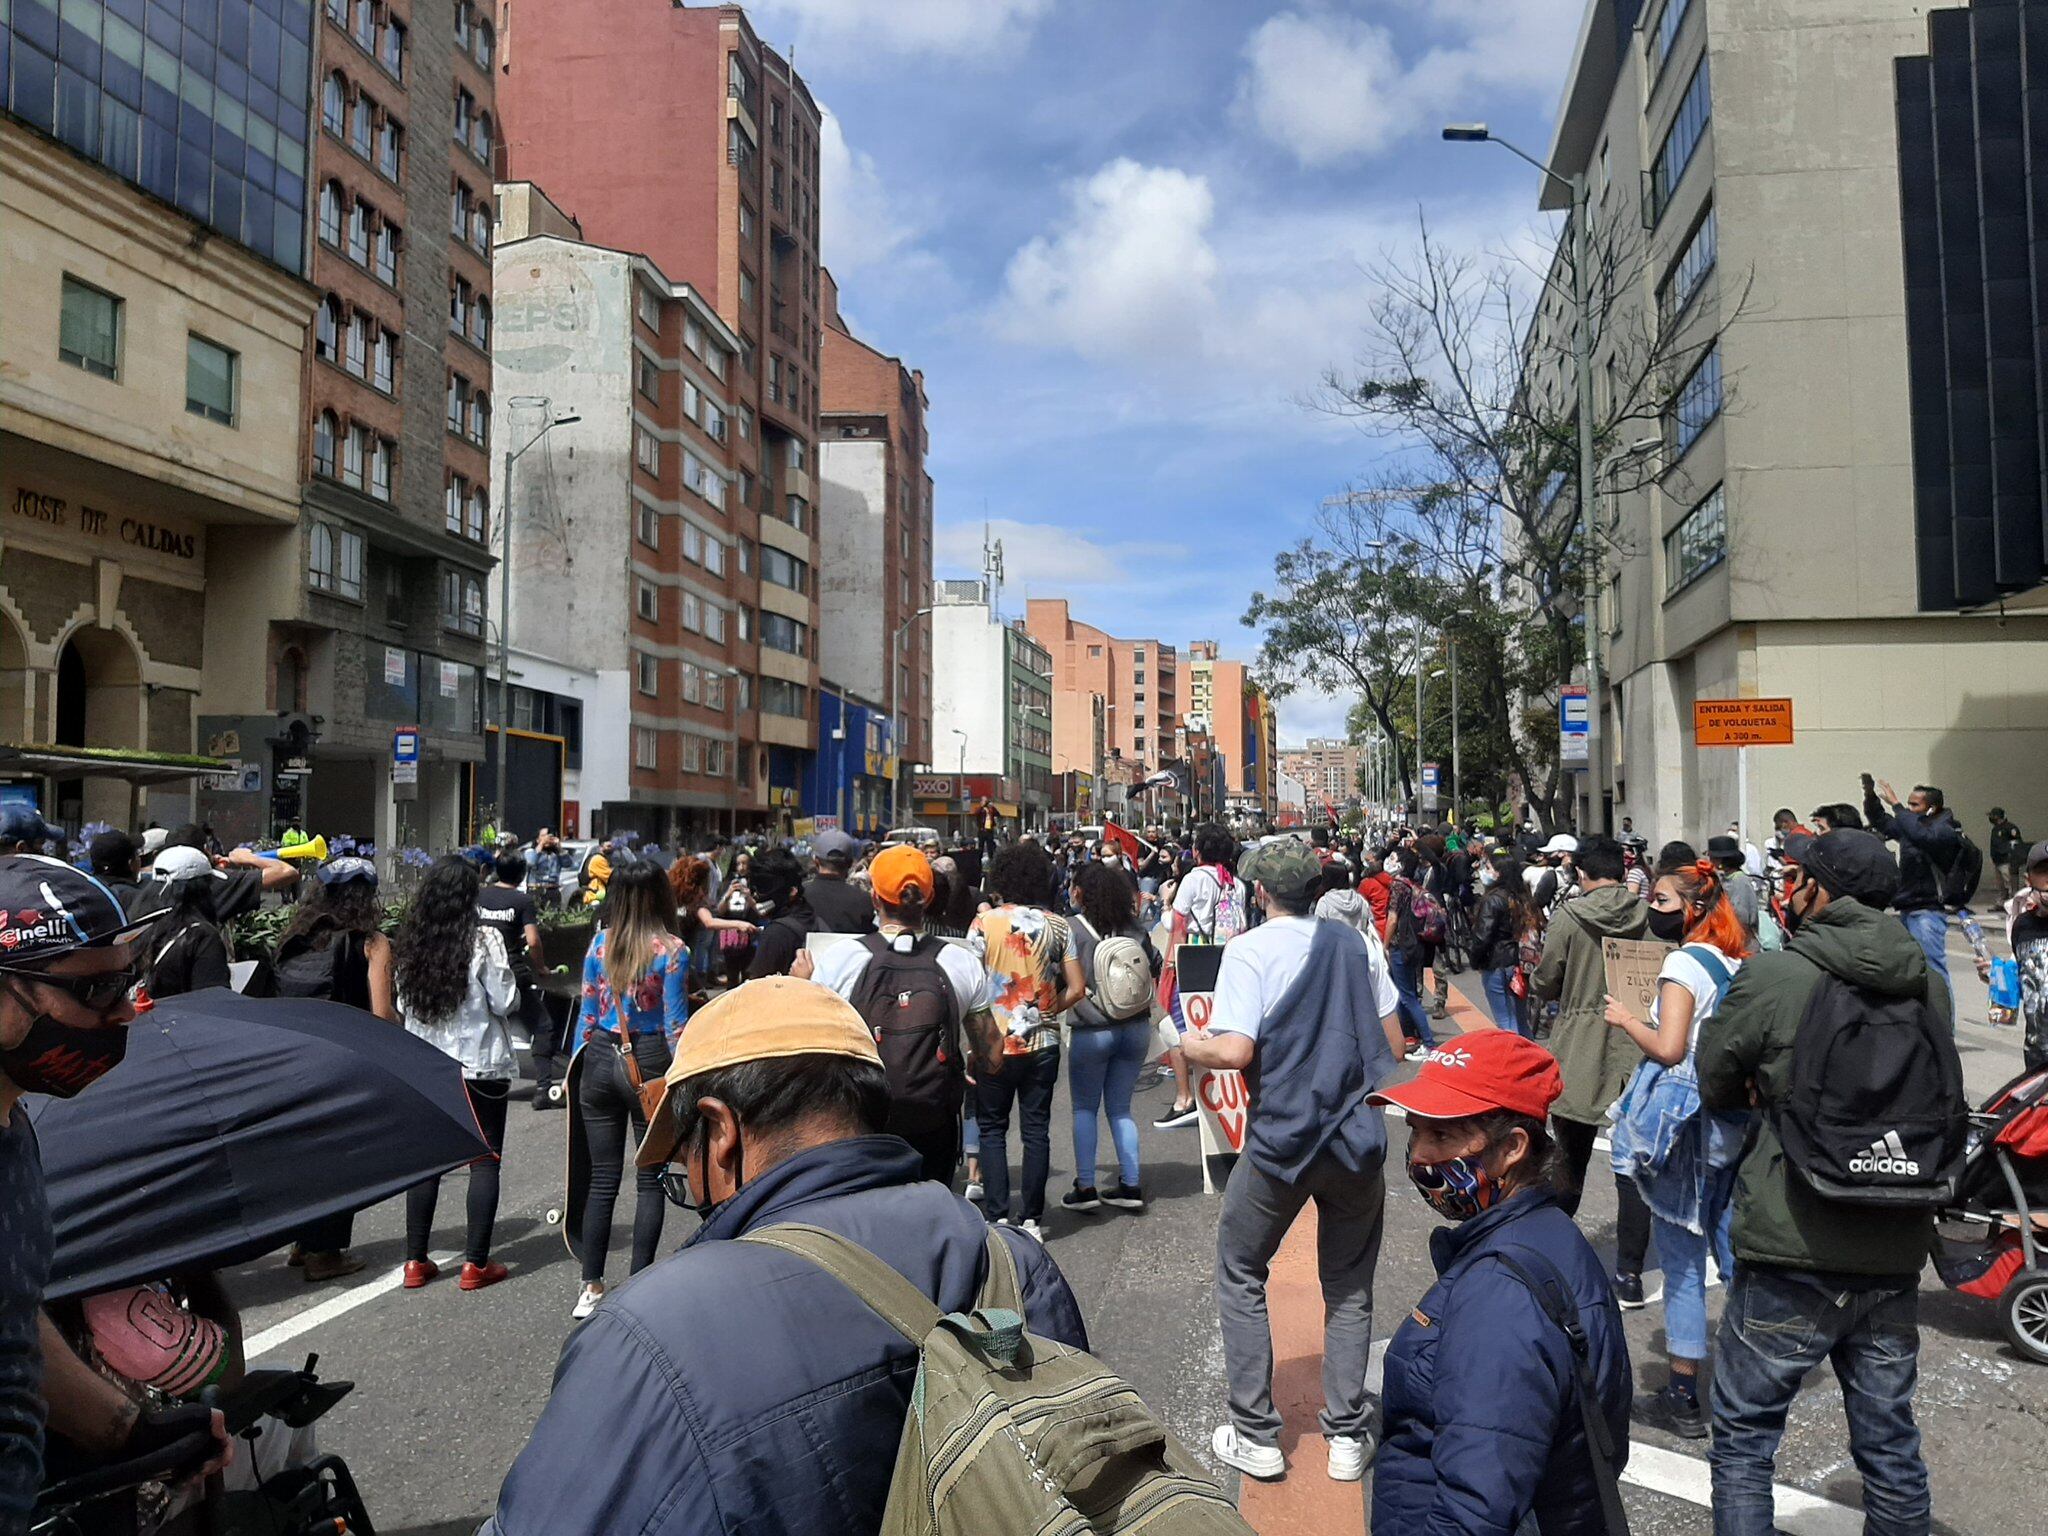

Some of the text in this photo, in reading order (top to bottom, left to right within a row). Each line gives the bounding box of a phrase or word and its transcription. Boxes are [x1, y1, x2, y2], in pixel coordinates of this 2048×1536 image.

[494, 303, 591, 333] EPSI
[12, 486, 67, 525] JOSE
[120, 518, 195, 560] CALDAS
[1699, 704, 1785, 714] ENTRADA Y SALIDA
[1708, 718, 1777, 727] DE VOLQUETAS
[1724, 732, 1731, 740] A
[1733, 732, 1749, 740] 300
[1423, 1049, 1455, 1066] aro
[1848, 1156, 1920, 1176] adidas
